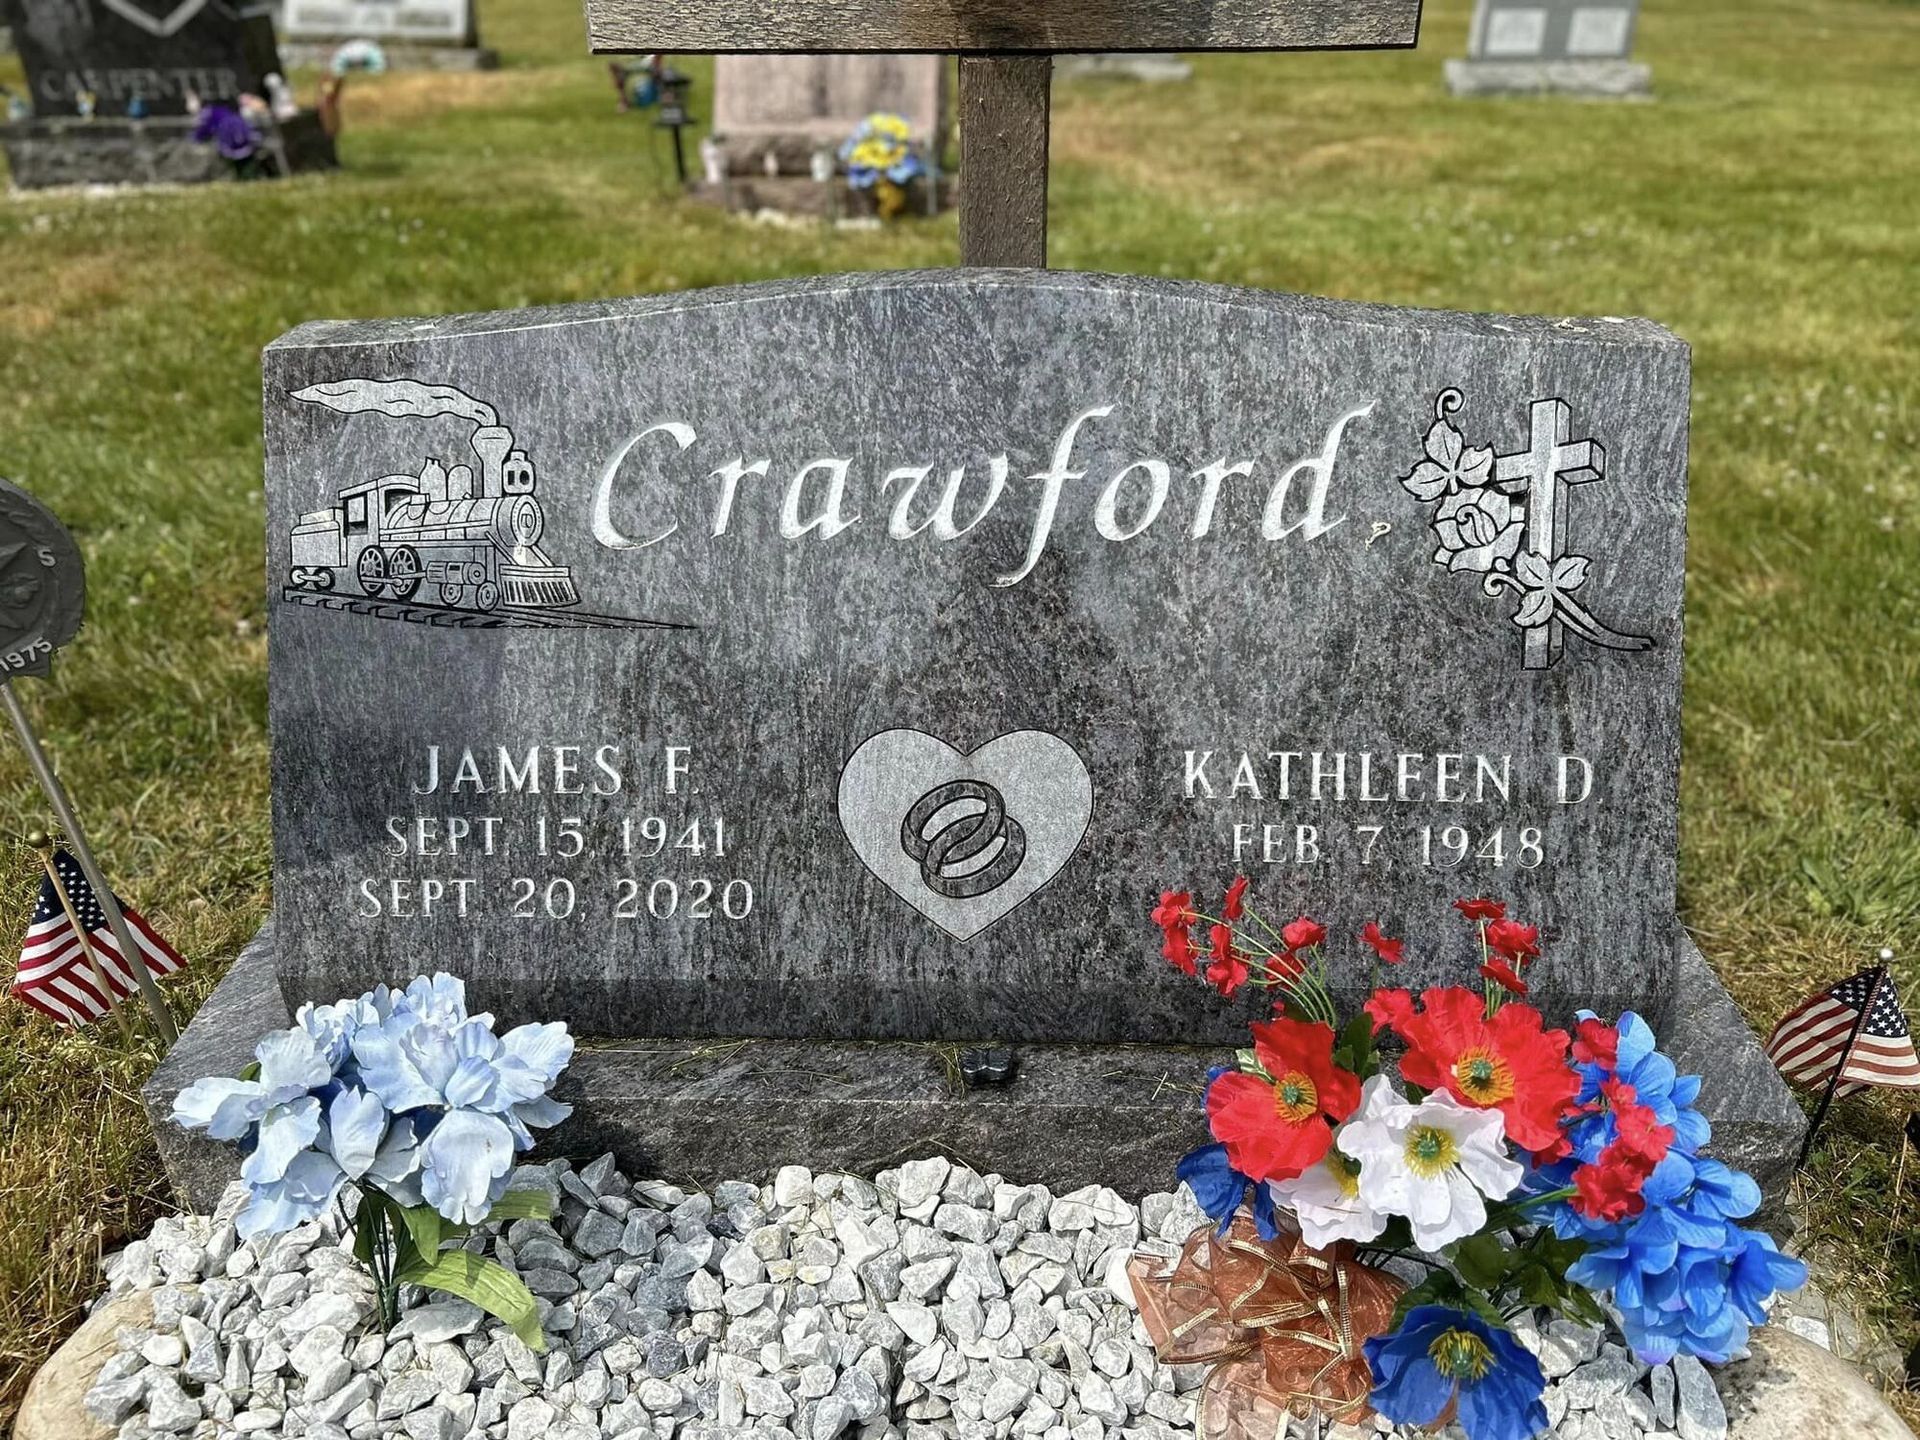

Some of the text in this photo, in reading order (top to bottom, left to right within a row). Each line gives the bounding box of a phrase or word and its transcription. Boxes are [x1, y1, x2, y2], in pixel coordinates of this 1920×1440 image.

[591, 402, 1376, 588] Crawford
[0, 636, 52, 671] 1975
[411, 744, 701, 796] JAMES F.
[1183, 750, 1511, 803] KATHLEEN
[621, 815, 726, 858] 1941
[1420, 825, 1545, 869] 1948
[510, 877, 587, 922] 20,
[614, 877, 754, 920] 2020
